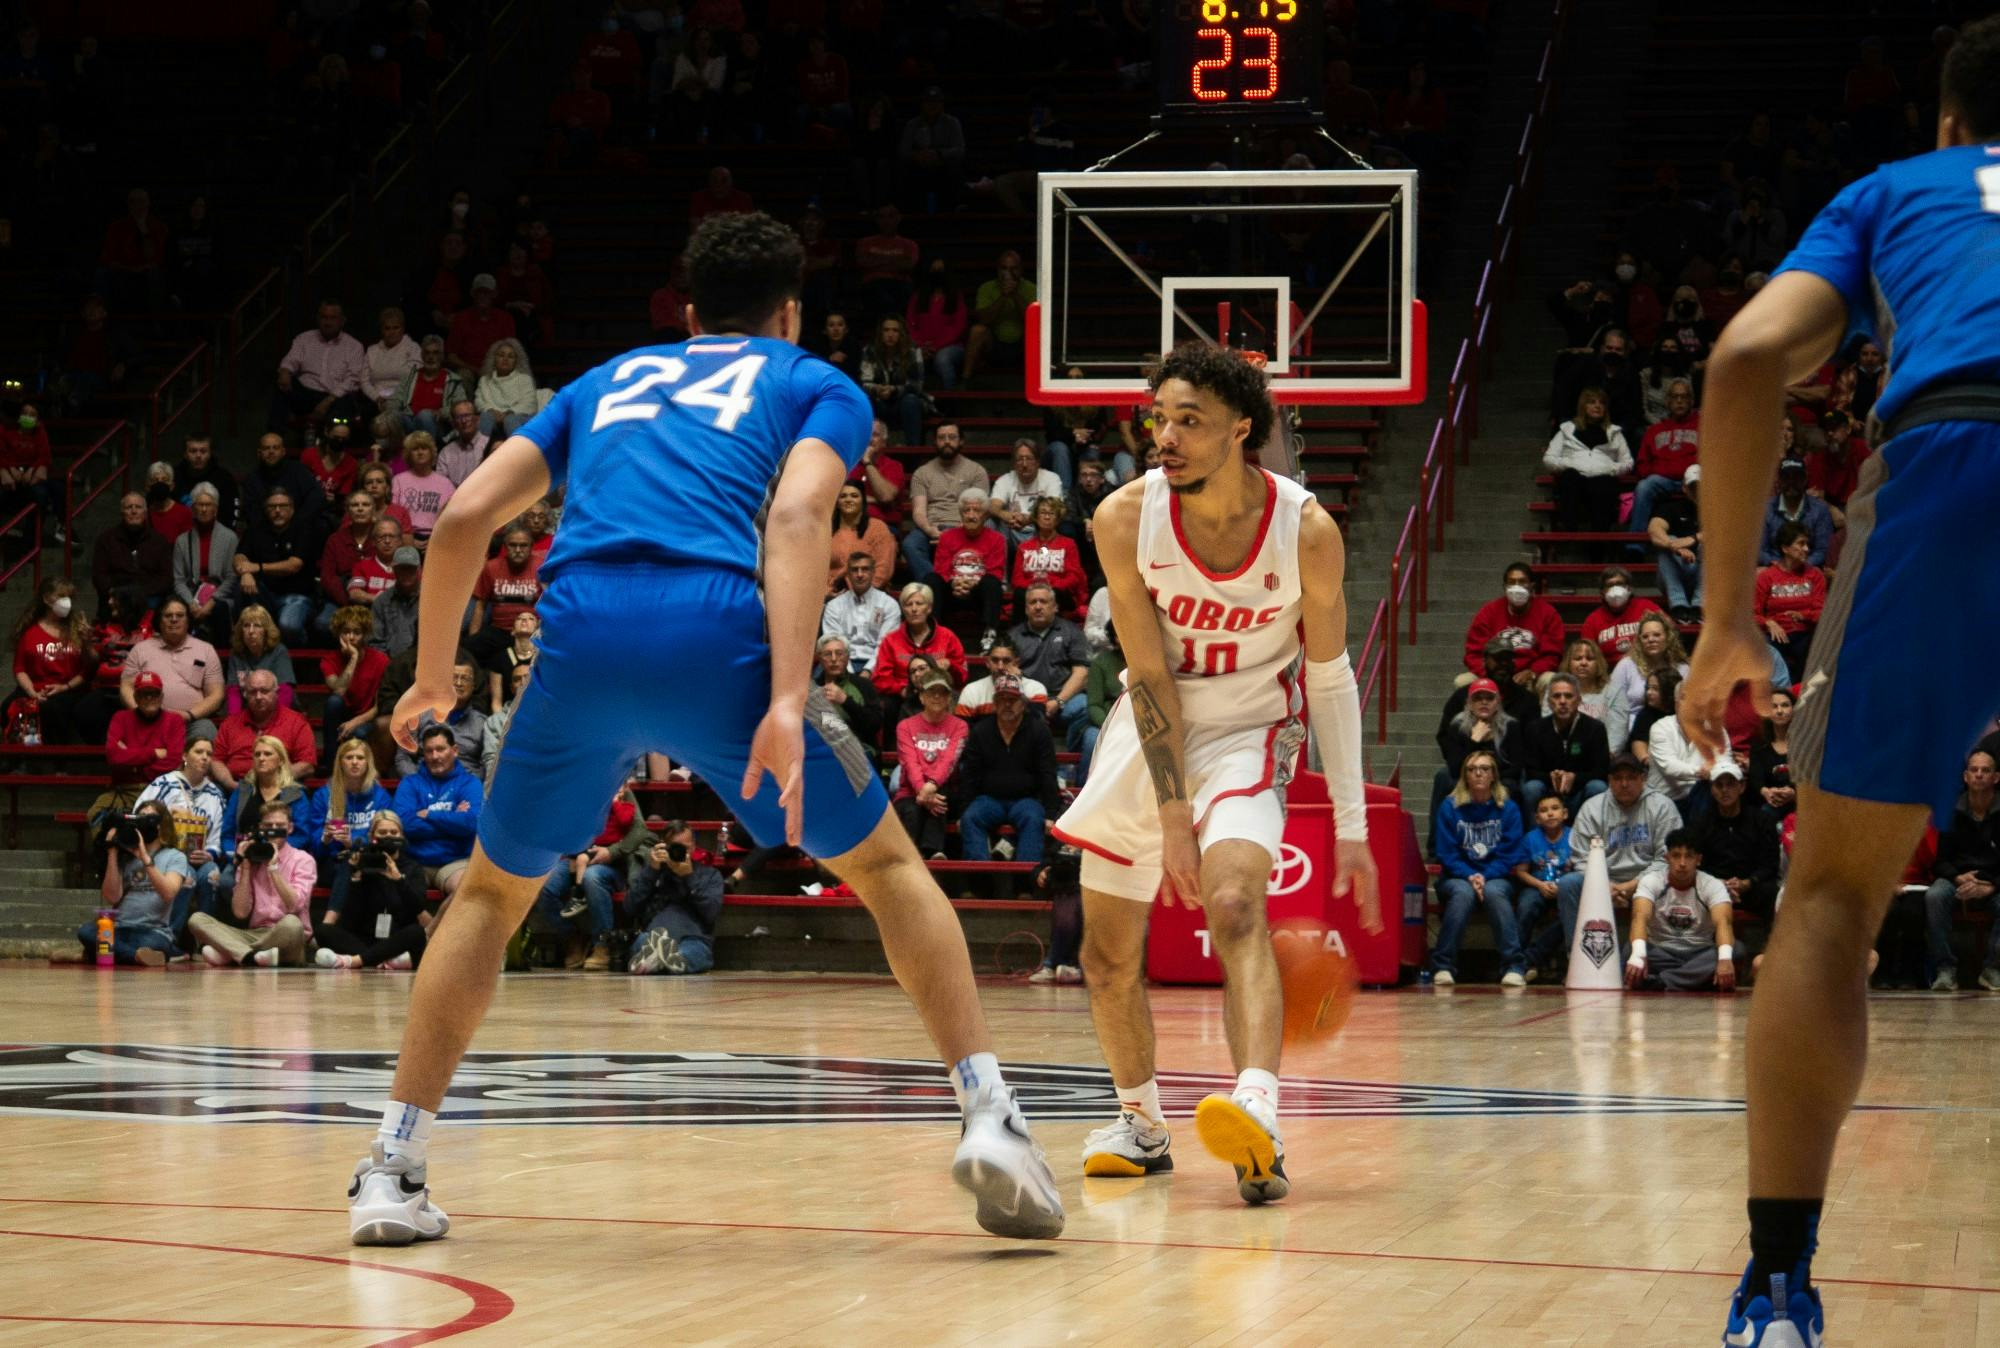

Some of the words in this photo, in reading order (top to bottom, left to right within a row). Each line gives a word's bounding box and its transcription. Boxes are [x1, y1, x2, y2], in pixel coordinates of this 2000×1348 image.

[1192, 27, 1278, 99] 23
[591, 354, 769, 433] 24
[1150, 586, 1284, 633] LOBOS
[1616, 621, 1640, 637] MEXI
[1177, 636, 1239, 678] 10
